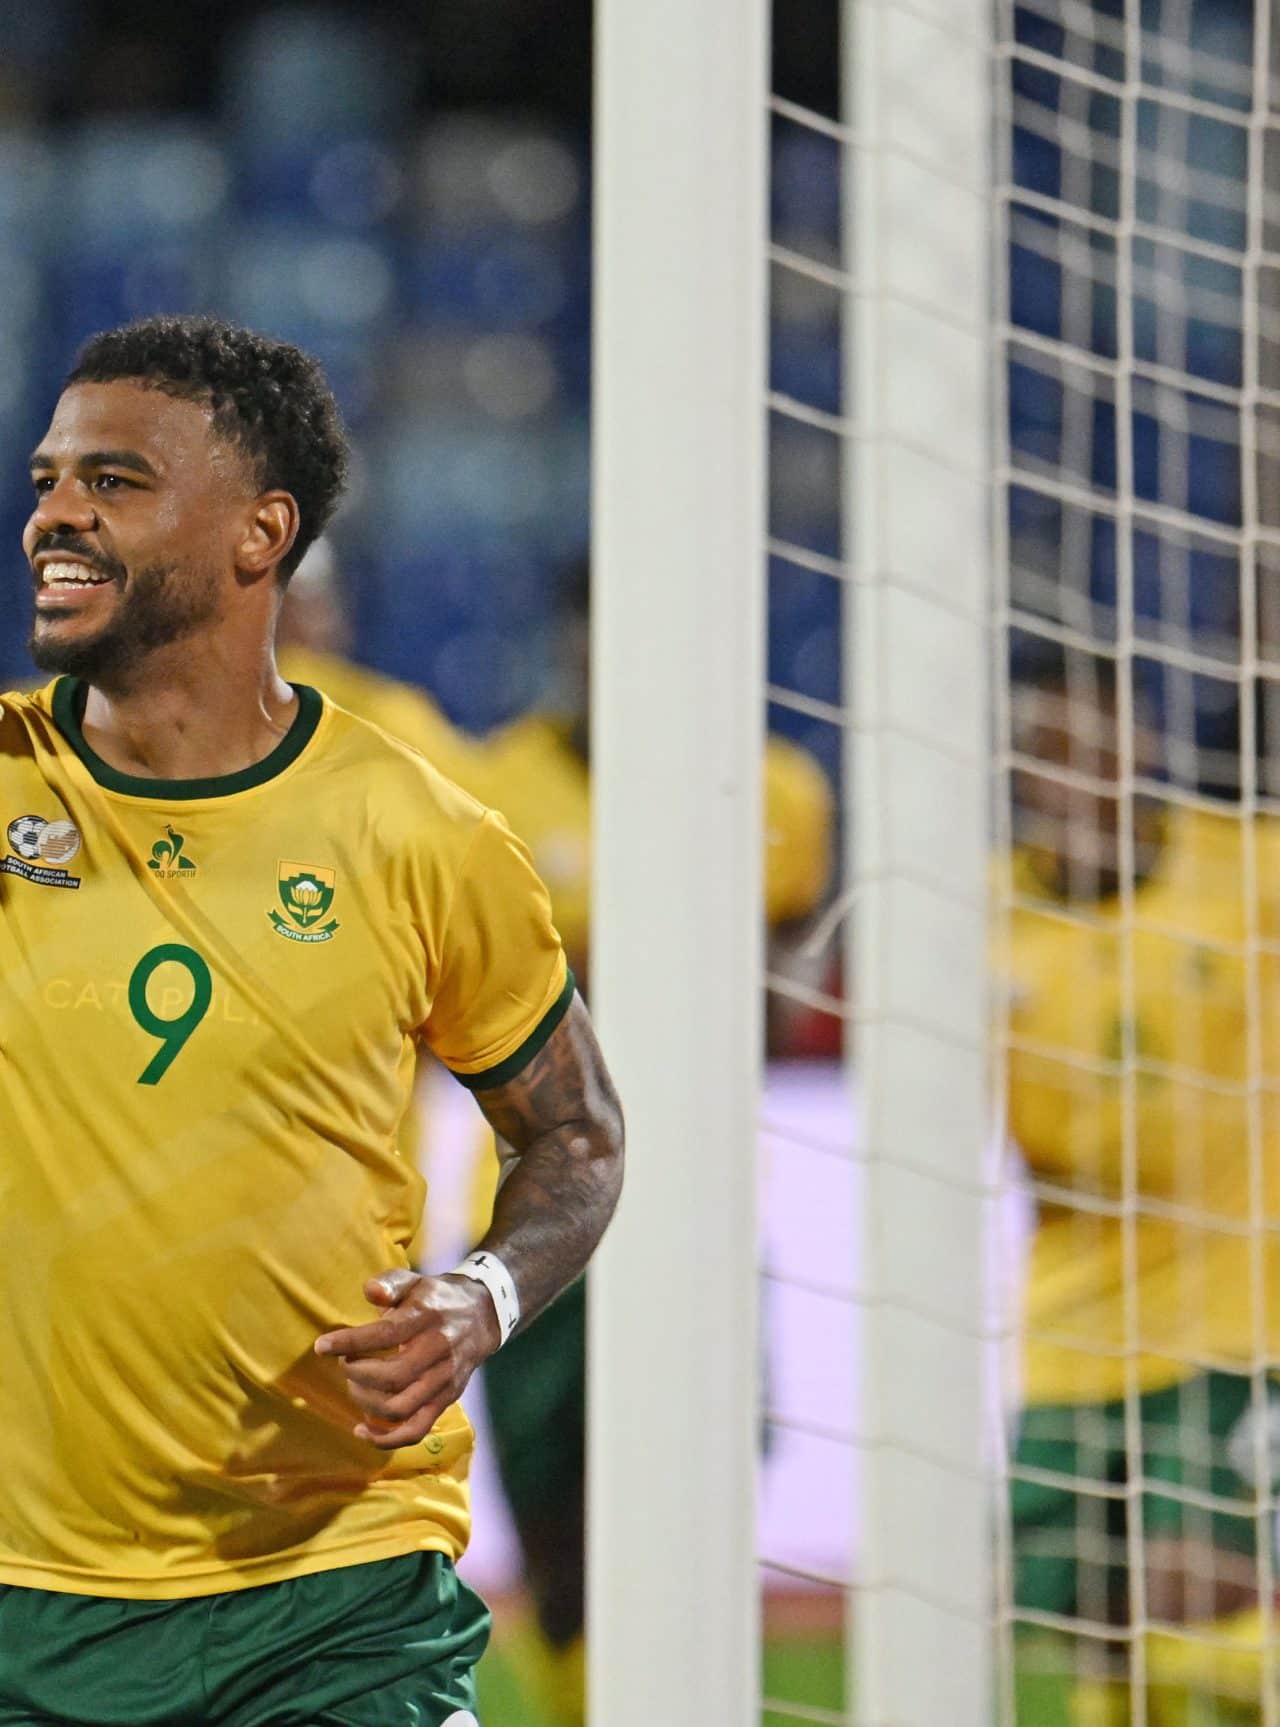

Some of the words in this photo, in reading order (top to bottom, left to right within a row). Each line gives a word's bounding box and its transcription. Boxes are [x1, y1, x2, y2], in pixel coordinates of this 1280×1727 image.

[7, 857, 32, 872] SOUTH
[33, 867, 66, 878] AFRICAN
[30, 874, 78, 887] ASSOCIATION
[276, 925, 302, 940] SOUTH
[303, 931, 331, 942] AFRICA
[128, 943, 213, 1085] 9
